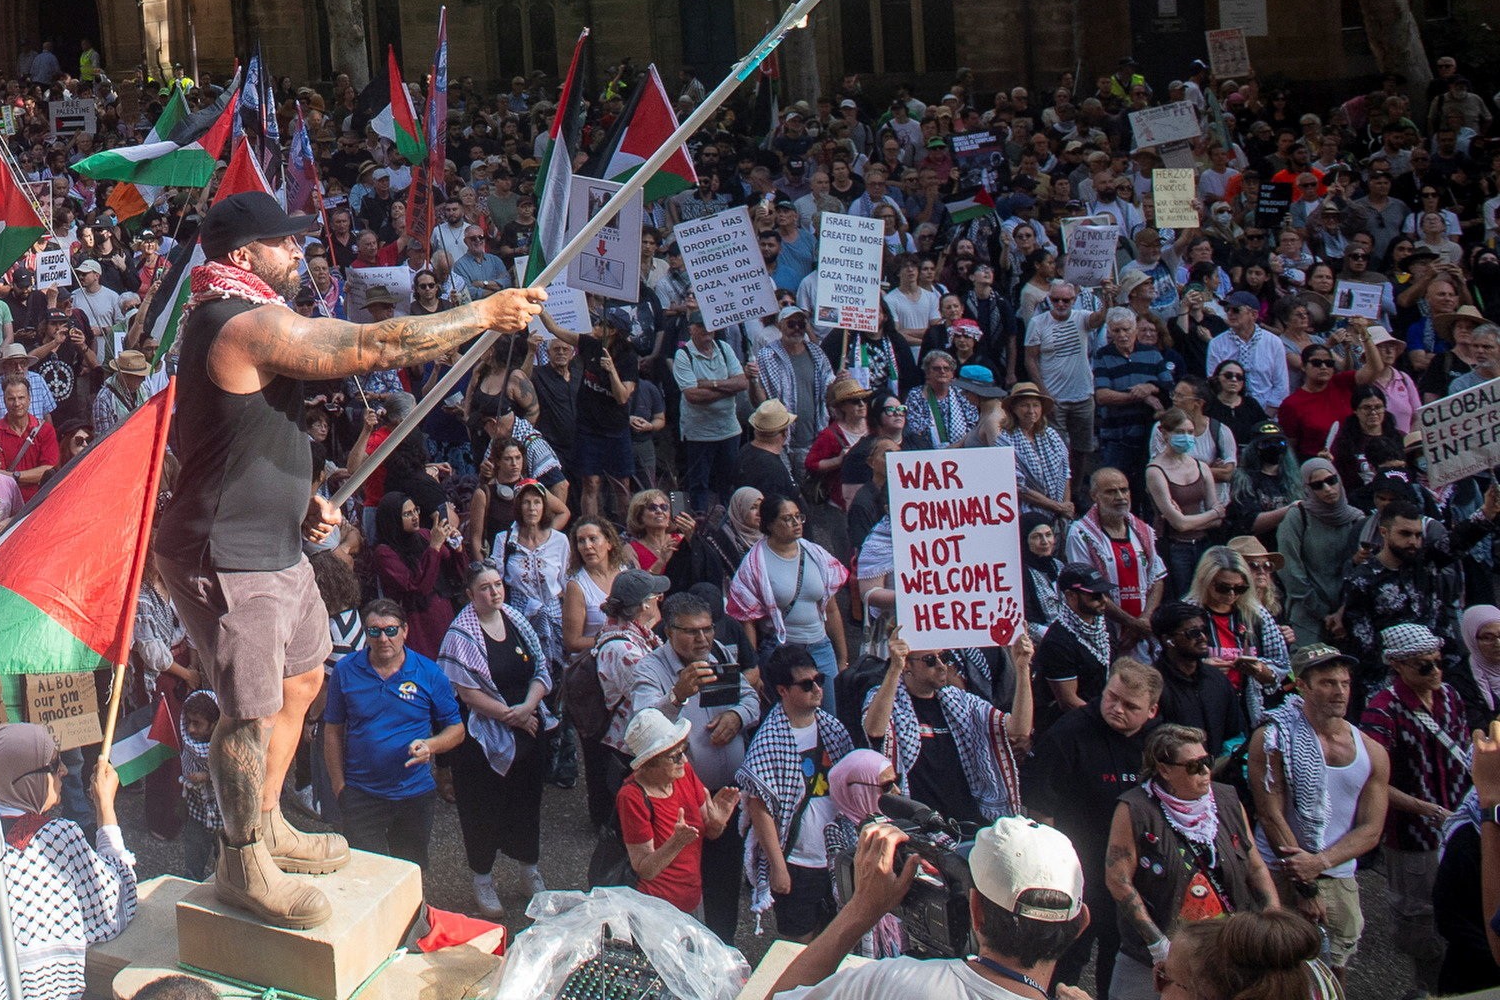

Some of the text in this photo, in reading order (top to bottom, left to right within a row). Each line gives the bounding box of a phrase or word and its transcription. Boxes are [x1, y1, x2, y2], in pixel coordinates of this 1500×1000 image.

[679, 216, 743, 239] ISRAEL HAS
[826, 216, 875, 231] ISRAEL HAS
[683, 233, 731, 254] DROPPED
[732, 231, 738, 239] 7
[822, 230, 882, 246] CREATED MORE
[1073, 229, 1118, 240] GENOCIDE
[40, 254, 65, 265] HERZOG
[690, 244, 749, 267] HIROSHIMA
[839, 246, 864, 256] CHILD
[693, 258, 751, 280] BOMBS ON
[820, 256, 878, 271] AMPUTEES IN
[1068, 258, 1110, 270] PROTEST
[40, 270, 68, 282] WELCOME
[696, 268, 765, 293] GAZA, WHICH
[820, 270, 879, 286] GAZA THAN IN
[706, 294, 716, 304] IS
[741, 282, 762, 294] THE
[834, 283, 864, 295] WORLD
[714, 296, 755, 315] SIZE OF
[830, 294, 866, 306] HISTORY
[712, 306, 767, 328] CANBERRA
[1421, 385, 1500, 428] GLOBAL
[896, 460, 964, 492] WAR
[900, 492, 1016, 533] CRIMINALS
[910, 534, 966, 570] NOT
[900, 562, 1013, 596] WELCOME
[913, 600, 989, 632] HERE
[38, 674, 74, 693] ALBO
[34, 690, 80, 708] our pm
[39, 704, 84, 726] ignores
